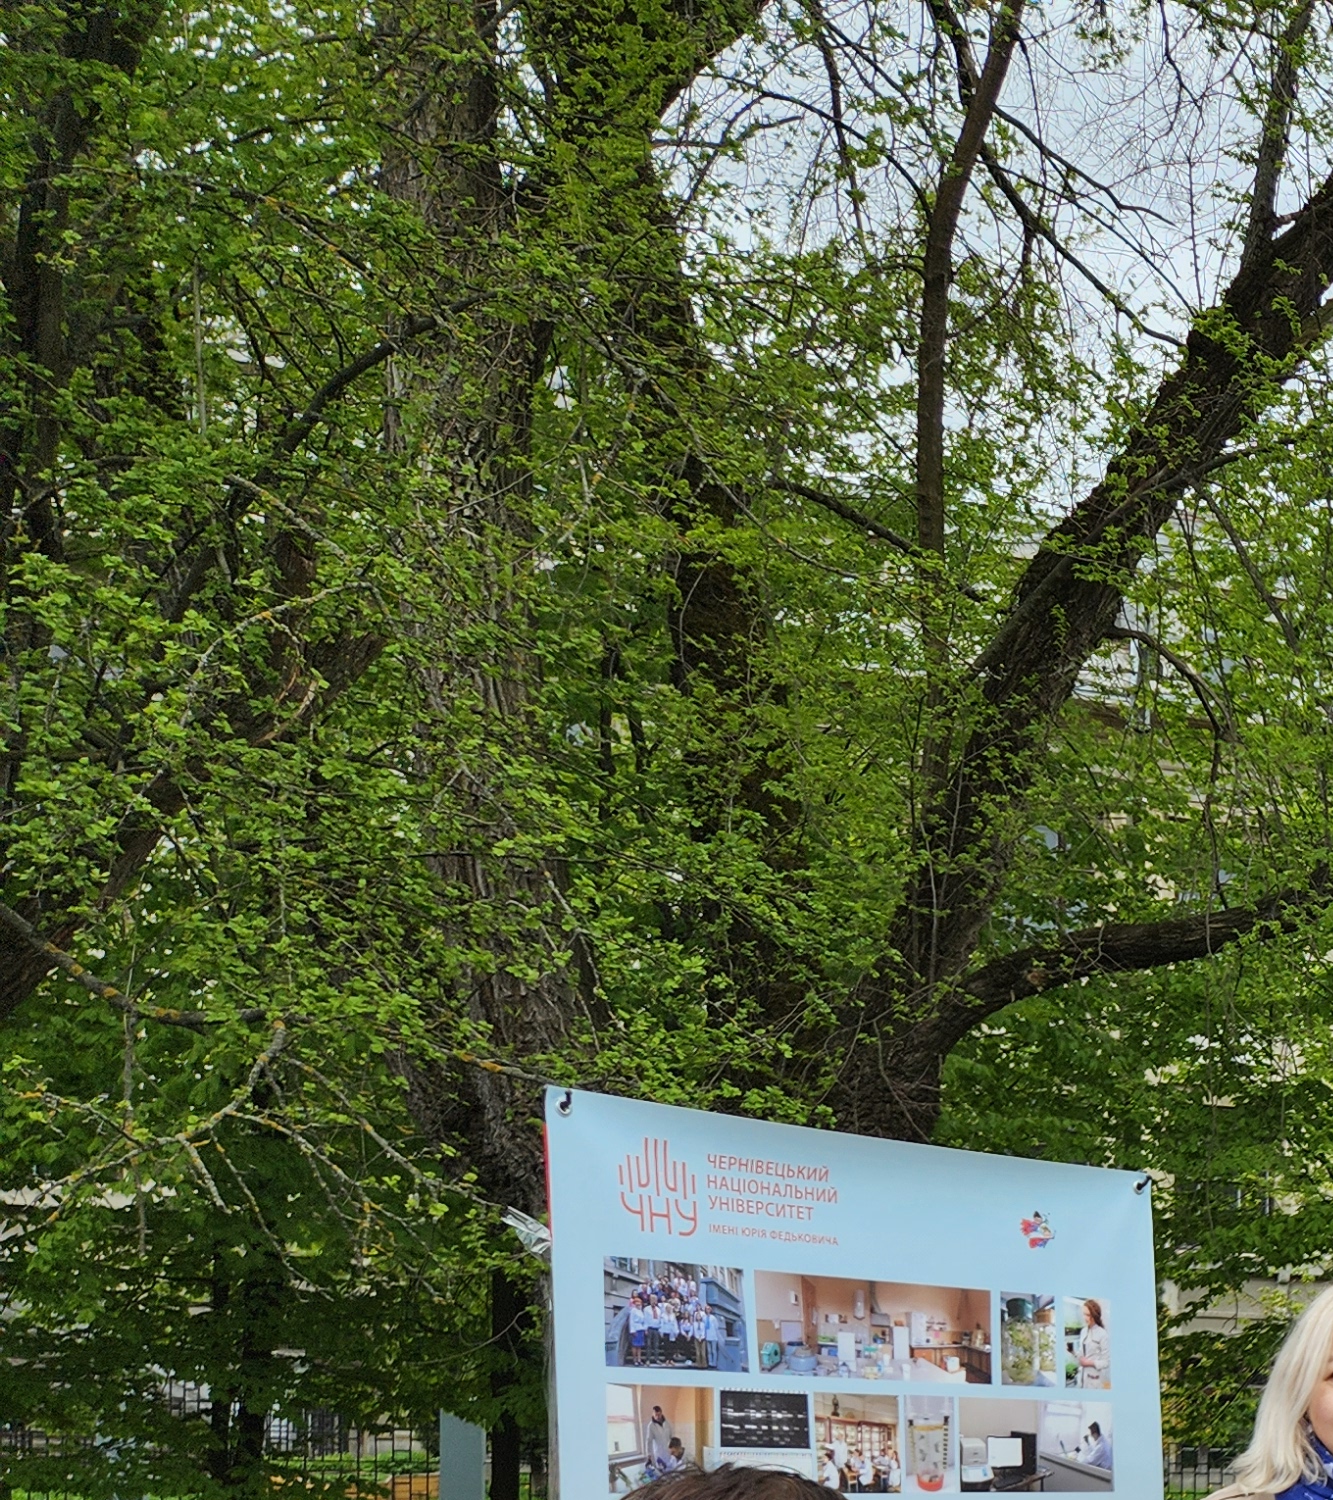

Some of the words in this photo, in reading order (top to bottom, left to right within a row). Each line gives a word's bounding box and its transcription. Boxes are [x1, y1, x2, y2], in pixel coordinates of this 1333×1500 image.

[707, 1153, 830, 1183] ЧЕРНІВЕЦЬКИЙ
[706, 1174, 838, 1204] НАЦІОНАЛЬНИЙ
[620, 1191, 697, 1237] ЧНУ
[707, 1195, 814, 1221] УНІВЕРСИТЕТ
[708, 1223, 739, 1236] ІМЕНІ
[741, 1227, 767, 1239] ЮРІЯ
[769, 1230, 839, 1246] ФЕДЬКОВИЧА
